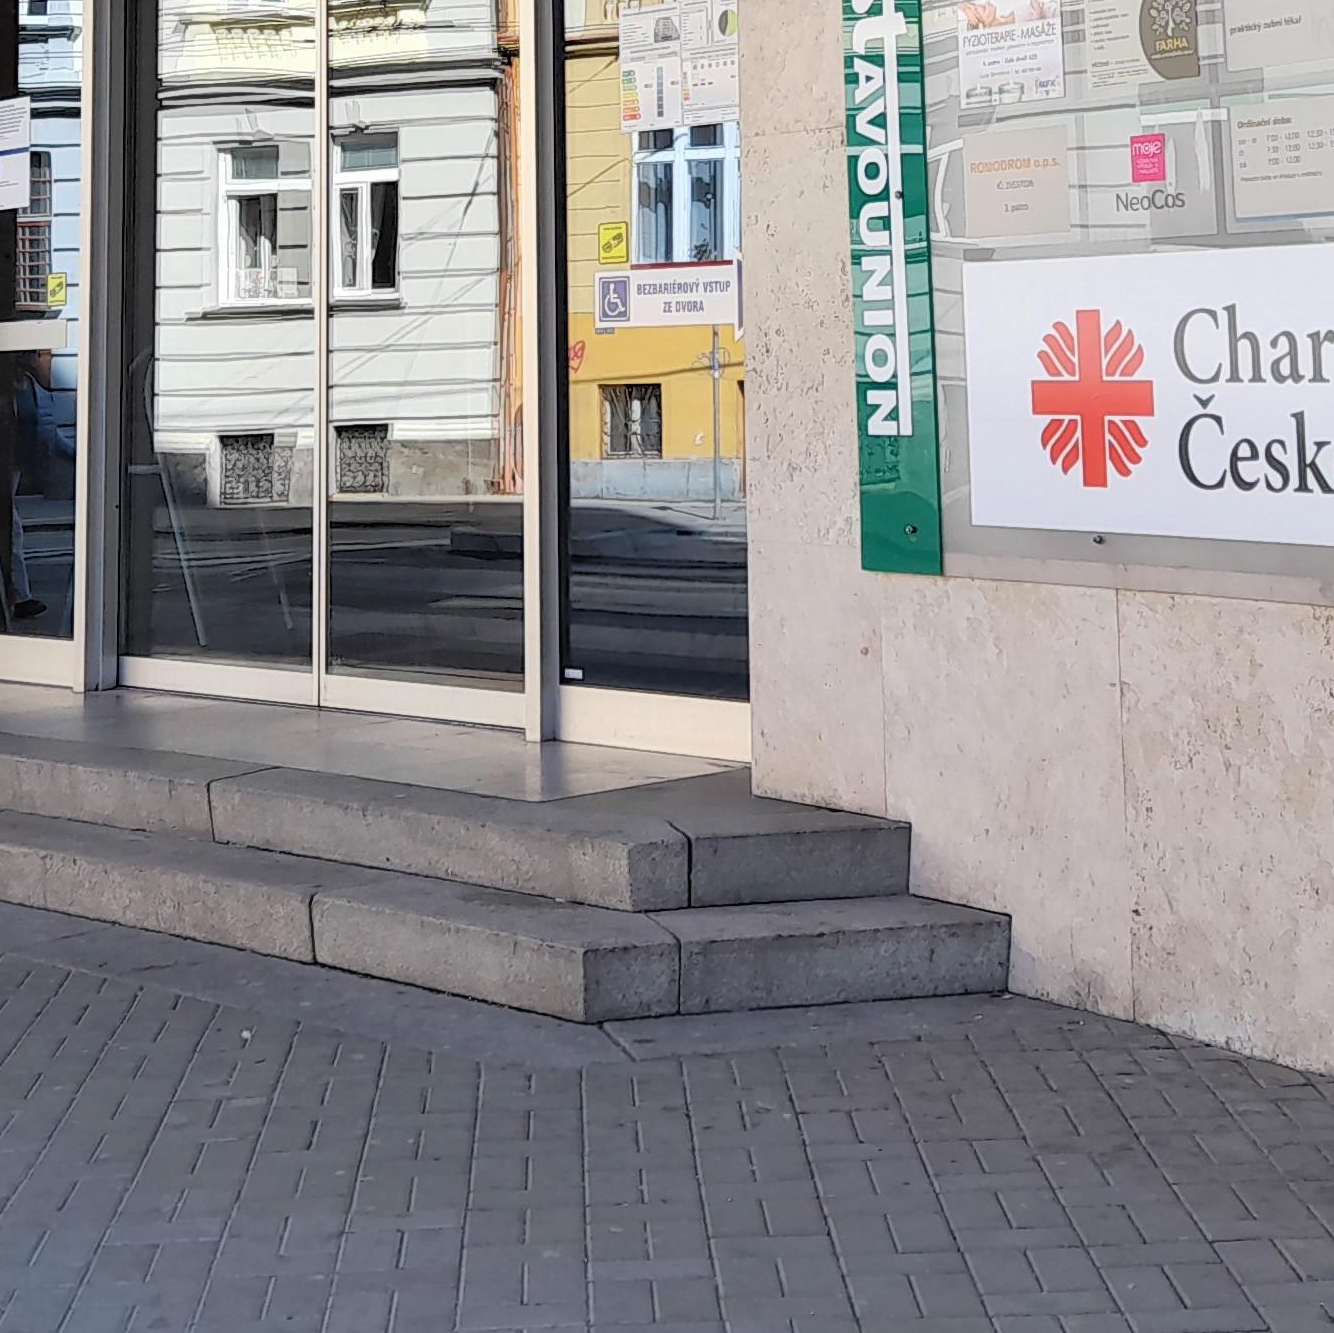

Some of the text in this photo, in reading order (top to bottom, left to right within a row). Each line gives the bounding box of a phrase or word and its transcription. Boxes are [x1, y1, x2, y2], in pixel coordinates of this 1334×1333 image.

[1116, 189, 1186, 212] NeoCos
[637, 278, 731, 295] BEZBARIÉROVÝ VSTUP
[663, 300, 704, 313] ZE DVORA
